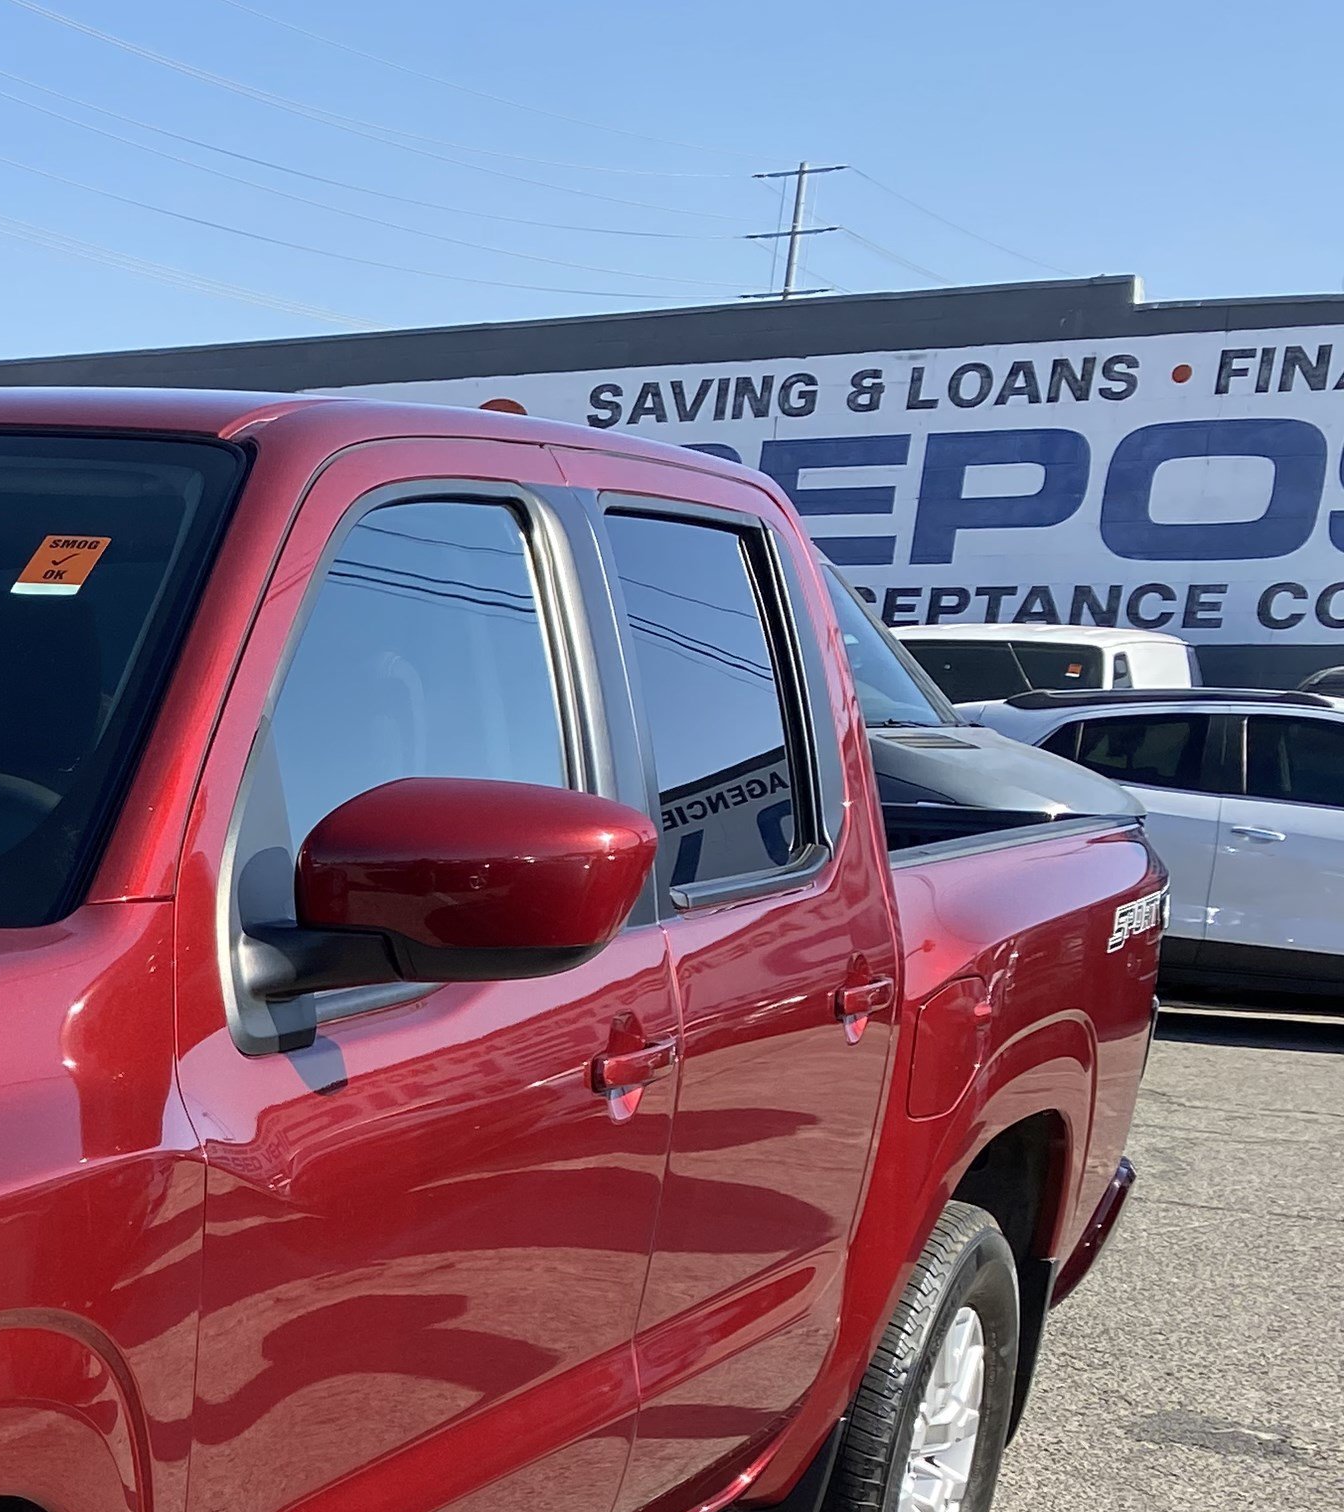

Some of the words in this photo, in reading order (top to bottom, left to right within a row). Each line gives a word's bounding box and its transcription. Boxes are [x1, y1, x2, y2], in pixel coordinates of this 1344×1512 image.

[586, 372, 819, 430] SAVING
[846, 368, 886, 413] &
[906, 353, 1141, 411] LOANS
[1214, 344, 1344, 396] FIN
[680, 418, 1344, 566] EPO
[49, 539, 101, 550] SMOG
[42, 569, 68, 580] OK
[854, 582, 1229, 630] EPTANCE
